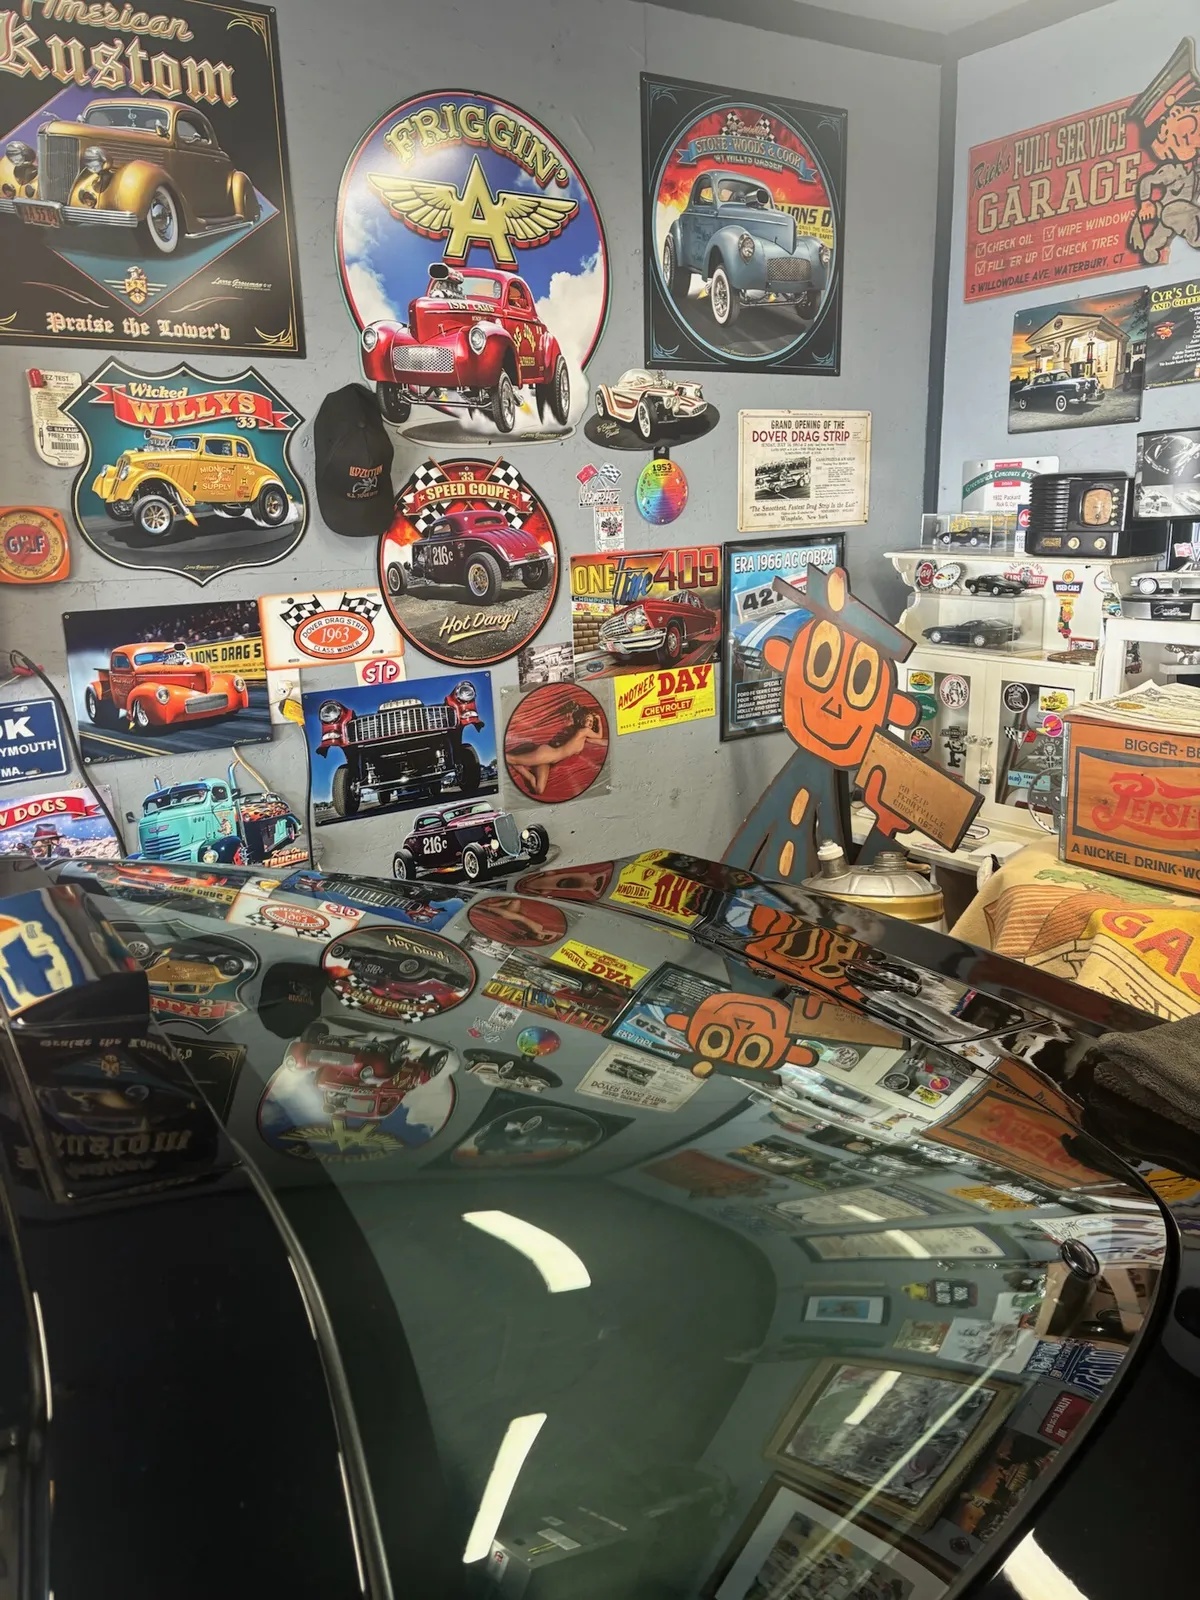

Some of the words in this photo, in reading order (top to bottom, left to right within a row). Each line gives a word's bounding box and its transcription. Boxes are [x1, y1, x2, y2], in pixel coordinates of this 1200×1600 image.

[0, 10, 239, 108] Kustom
[385, 102, 570, 189] FRIGGIN'
[695, 137, 728, 152] STONE
[732, 137, 766, 156] WOODS
[767, 145, 775, 158] &
[776, 145, 802, 168] COOK
[1012, 131, 1053, 181] FULL
[1055, 106, 1129, 168] SERVICE
[976, 151, 1142, 236] GARAGE
[443, 153, 519, 270] A
[1056, 222, 1083, 238] WIPE
[1085, 209, 1136, 232] WINDOWS
[987, 238, 1016, 254] CHECK
[1019, 233, 1034, 246] OIL
[1055, 241, 1088, 258] CHECK
[1091, 233, 1120, 250] TIRES
[987, 258, 1006, 272] FILL
[1025, 251, 1038, 264] UP
[970, 283, 976, 294] 5
[977, 272, 1030, 292] WILLOWDALE
[1113, 252, 1125, 265] CT
[1151, 301, 1171, 313] AND
[46, 311, 114, 335] Praise
[123, 316, 150, 338] the
[157, 319, 231, 342] Lower'd
[129, 382, 187, 399] Wicked
[129, 392, 257, 424] WILLYS
[770, 419, 792, 430] GRAND
[794, 420, 821, 430] OPENING
[823, 420, 831, 429] OF
[833, 420, 845, 429] THE
[752, 430, 788, 443] DOVER
[791, 430, 820, 443] DRAG
[823, 430, 850, 442] STRIP
[200, 465, 236, 475] MIDNIGHT
[652, 462, 672, 471] 1953
[202, 483, 232, 491] SUPPLY
[425, 482, 466, 501] SPEED
[468, 482, 511, 501] COUPE
[734, 555, 755, 573] ERA
[757, 553, 782, 571] 1966
[784, 551, 798, 569] AC
[800, 547, 834, 566] COBRA
[573, 563, 615, 595] ONE
[654, 548, 719, 592] 409
[1055, 583, 1067, 591] USED
[1067, 584, 1080, 592] CARS
[302, 620, 324, 639] DOVER
[325, 617, 346, 625] DRAG
[346, 619, 368, 633] STRIP
[438, 613, 472, 637] Hot
[472, 609, 519, 631] Dang!
[321, 626, 350, 643] 1963
[190, 648, 218, 664] LIONS
[221, 644, 250, 662] DRAG
[254, 643, 261, 658] S
[313, 644, 335, 654] CLASS
[337, 640, 360, 653] WINNER
[365, 660, 397, 684] STP
[618, 673, 655, 710] ANOTHER
[657, 664, 712, 698] DAY
[644, 700, 691, 716] CHEVROLET
[1124, 738, 1178, 756] BIGGER
[1, 766, 24, 778] MA.
[14, 798, 67, 822] DOGS
[896, 791, 946, 830] TERRYVILLE
[913, 794, 929, 806] ZIP
[262, 851, 309, 867] TRUCKIN
[1071, 843, 1080, 854] A
[1083, 844, 1130, 865] NICKEL
[1134, 856, 1176, 876] DRINK
